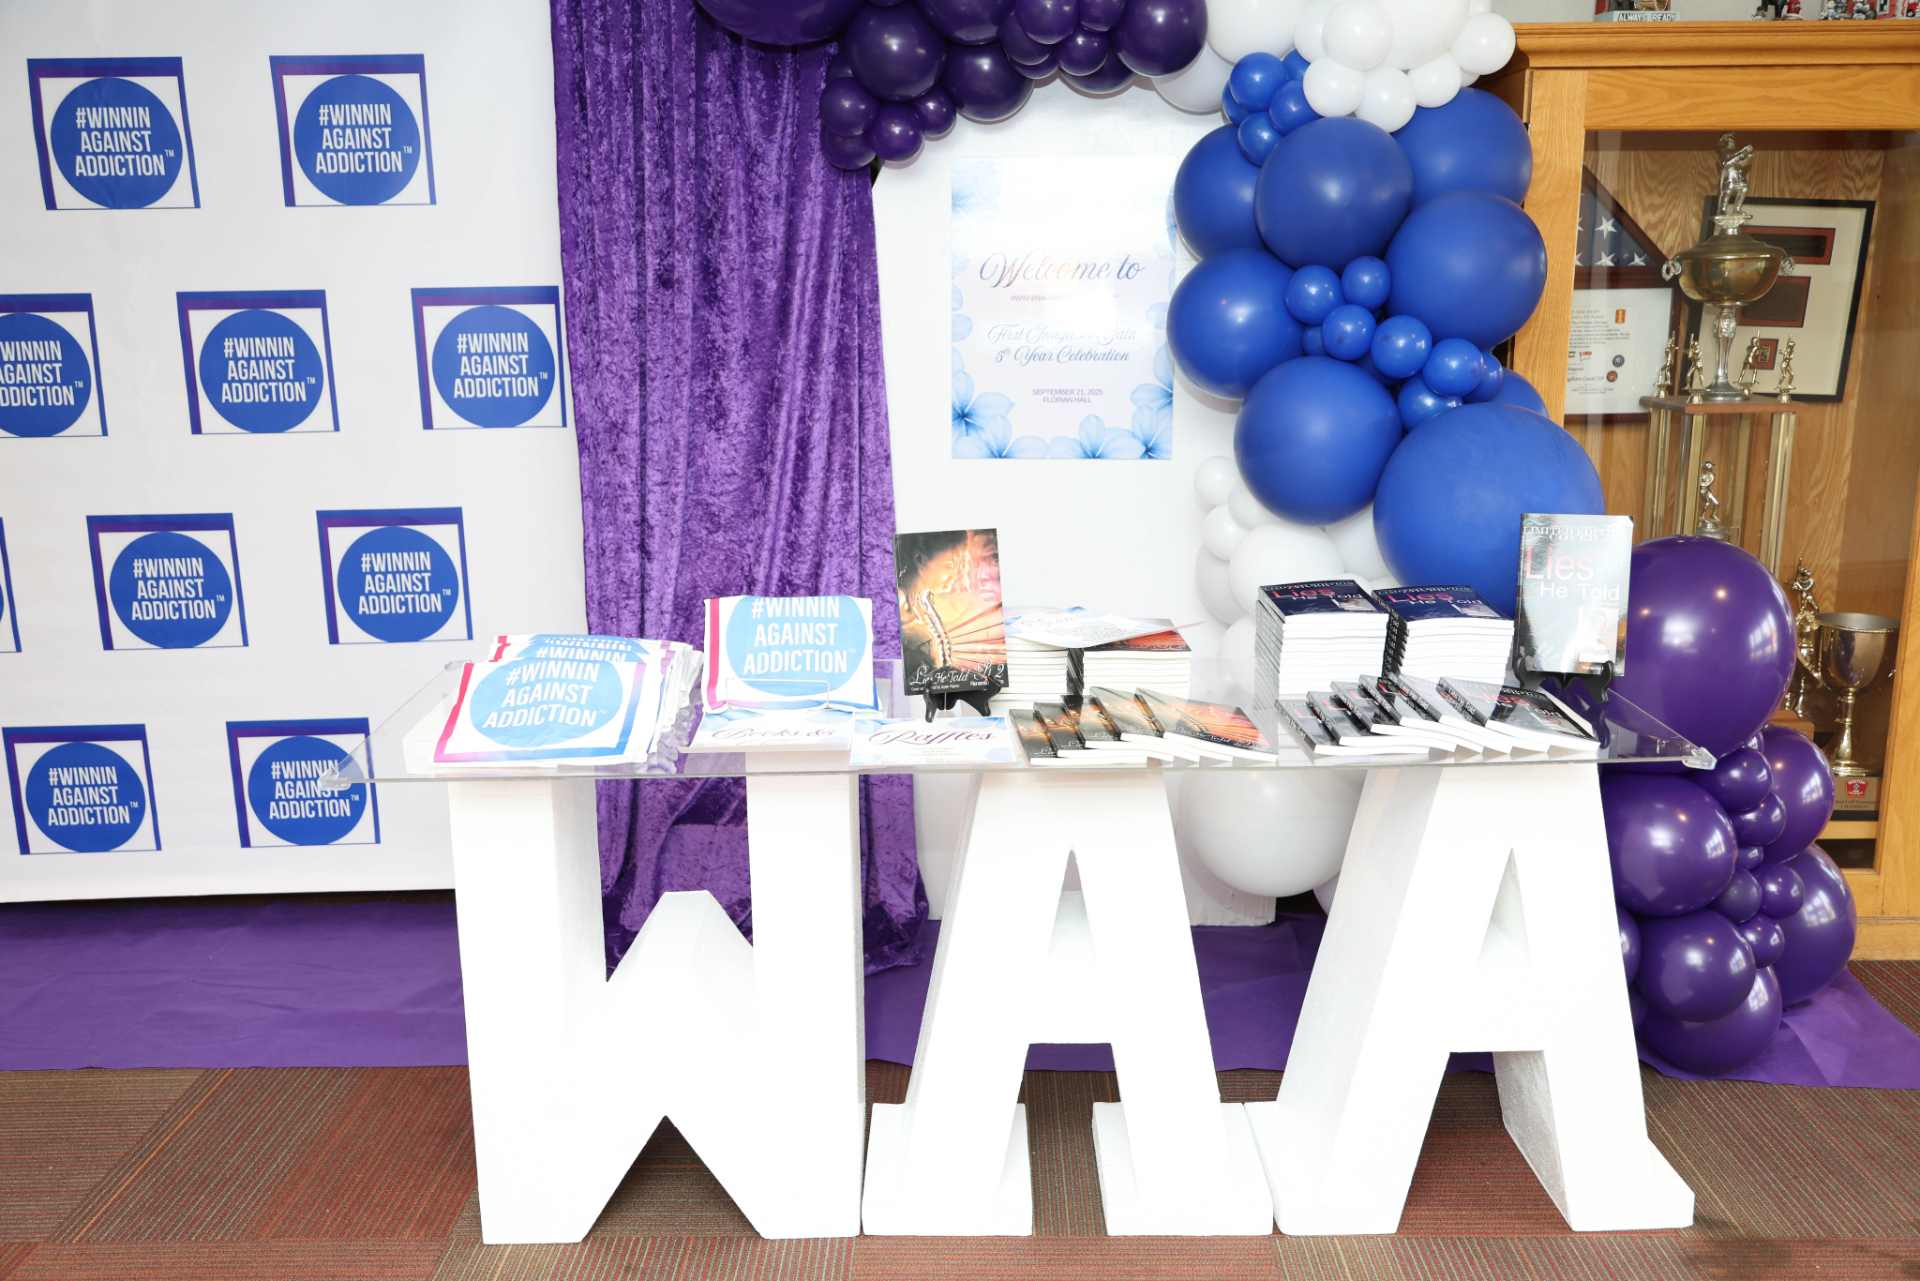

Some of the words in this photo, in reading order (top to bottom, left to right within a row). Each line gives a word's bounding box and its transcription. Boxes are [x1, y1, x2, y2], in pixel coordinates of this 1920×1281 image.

[76, 107, 150, 129] #WINNIN
[319, 103, 391, 127] #WINNIN
[81, 130, 152, 153] AGAINST
[322, 127, 391, 150] AGAINST
[76, 154, 166, 177] ADDICTION
[316, 151, 403, 174] ADDICTION
[979, 250, 1112, 288] Welcome
[1116, 254, 1146, 280] to
[0, 341, 63, 362] WINNIN
[224, 336, 295, 359] #WINNIN
[456, 332, 529, 355] #WINNIN
[1056, 345, 1129, 364] Celebration
[228, 358, 296, 381] AGAINST
[460, 354, 530, 377] AGAINST
[0, 385, 75, 407] DDICTION
[222, 381, 306, 404] ADDICTION
[454, 376, 540, 400] ADDICTION
[133, 557, 204, 579] #WINNIN
[361, 551, 431, 573] #WINNIN
[1526, 546, 1594, 581] Lies
[138, 578, 205, 600] AGAINST
[365, 572, 432, 594] AGAINST
[1539, 581, 1568, 599] He
[1577, 583, 1620, 601] Told
[132, 599, 217, 621] ADDICTION
[358, 593, 443, 615] ADDICTION
[752, 597, 840, 619] #WINNIN
[754, 623, 838, 646] AGAINST
[505, 658, 600, 685] #WINNIN
[743, 650, 848, 674] ADDICTION
[501, 682, 593, 707] AGAINST
[482, 704, 597, 728] ADDICTION
[869, 729, 993, 745] Raffles
[48, 766, 118, 786] #WINNIN
[53, 786, 119, 806] AGAINST
[48, 806, 131, 826] ADDICTION
[269, 798, 352, 820] ADDICTION
